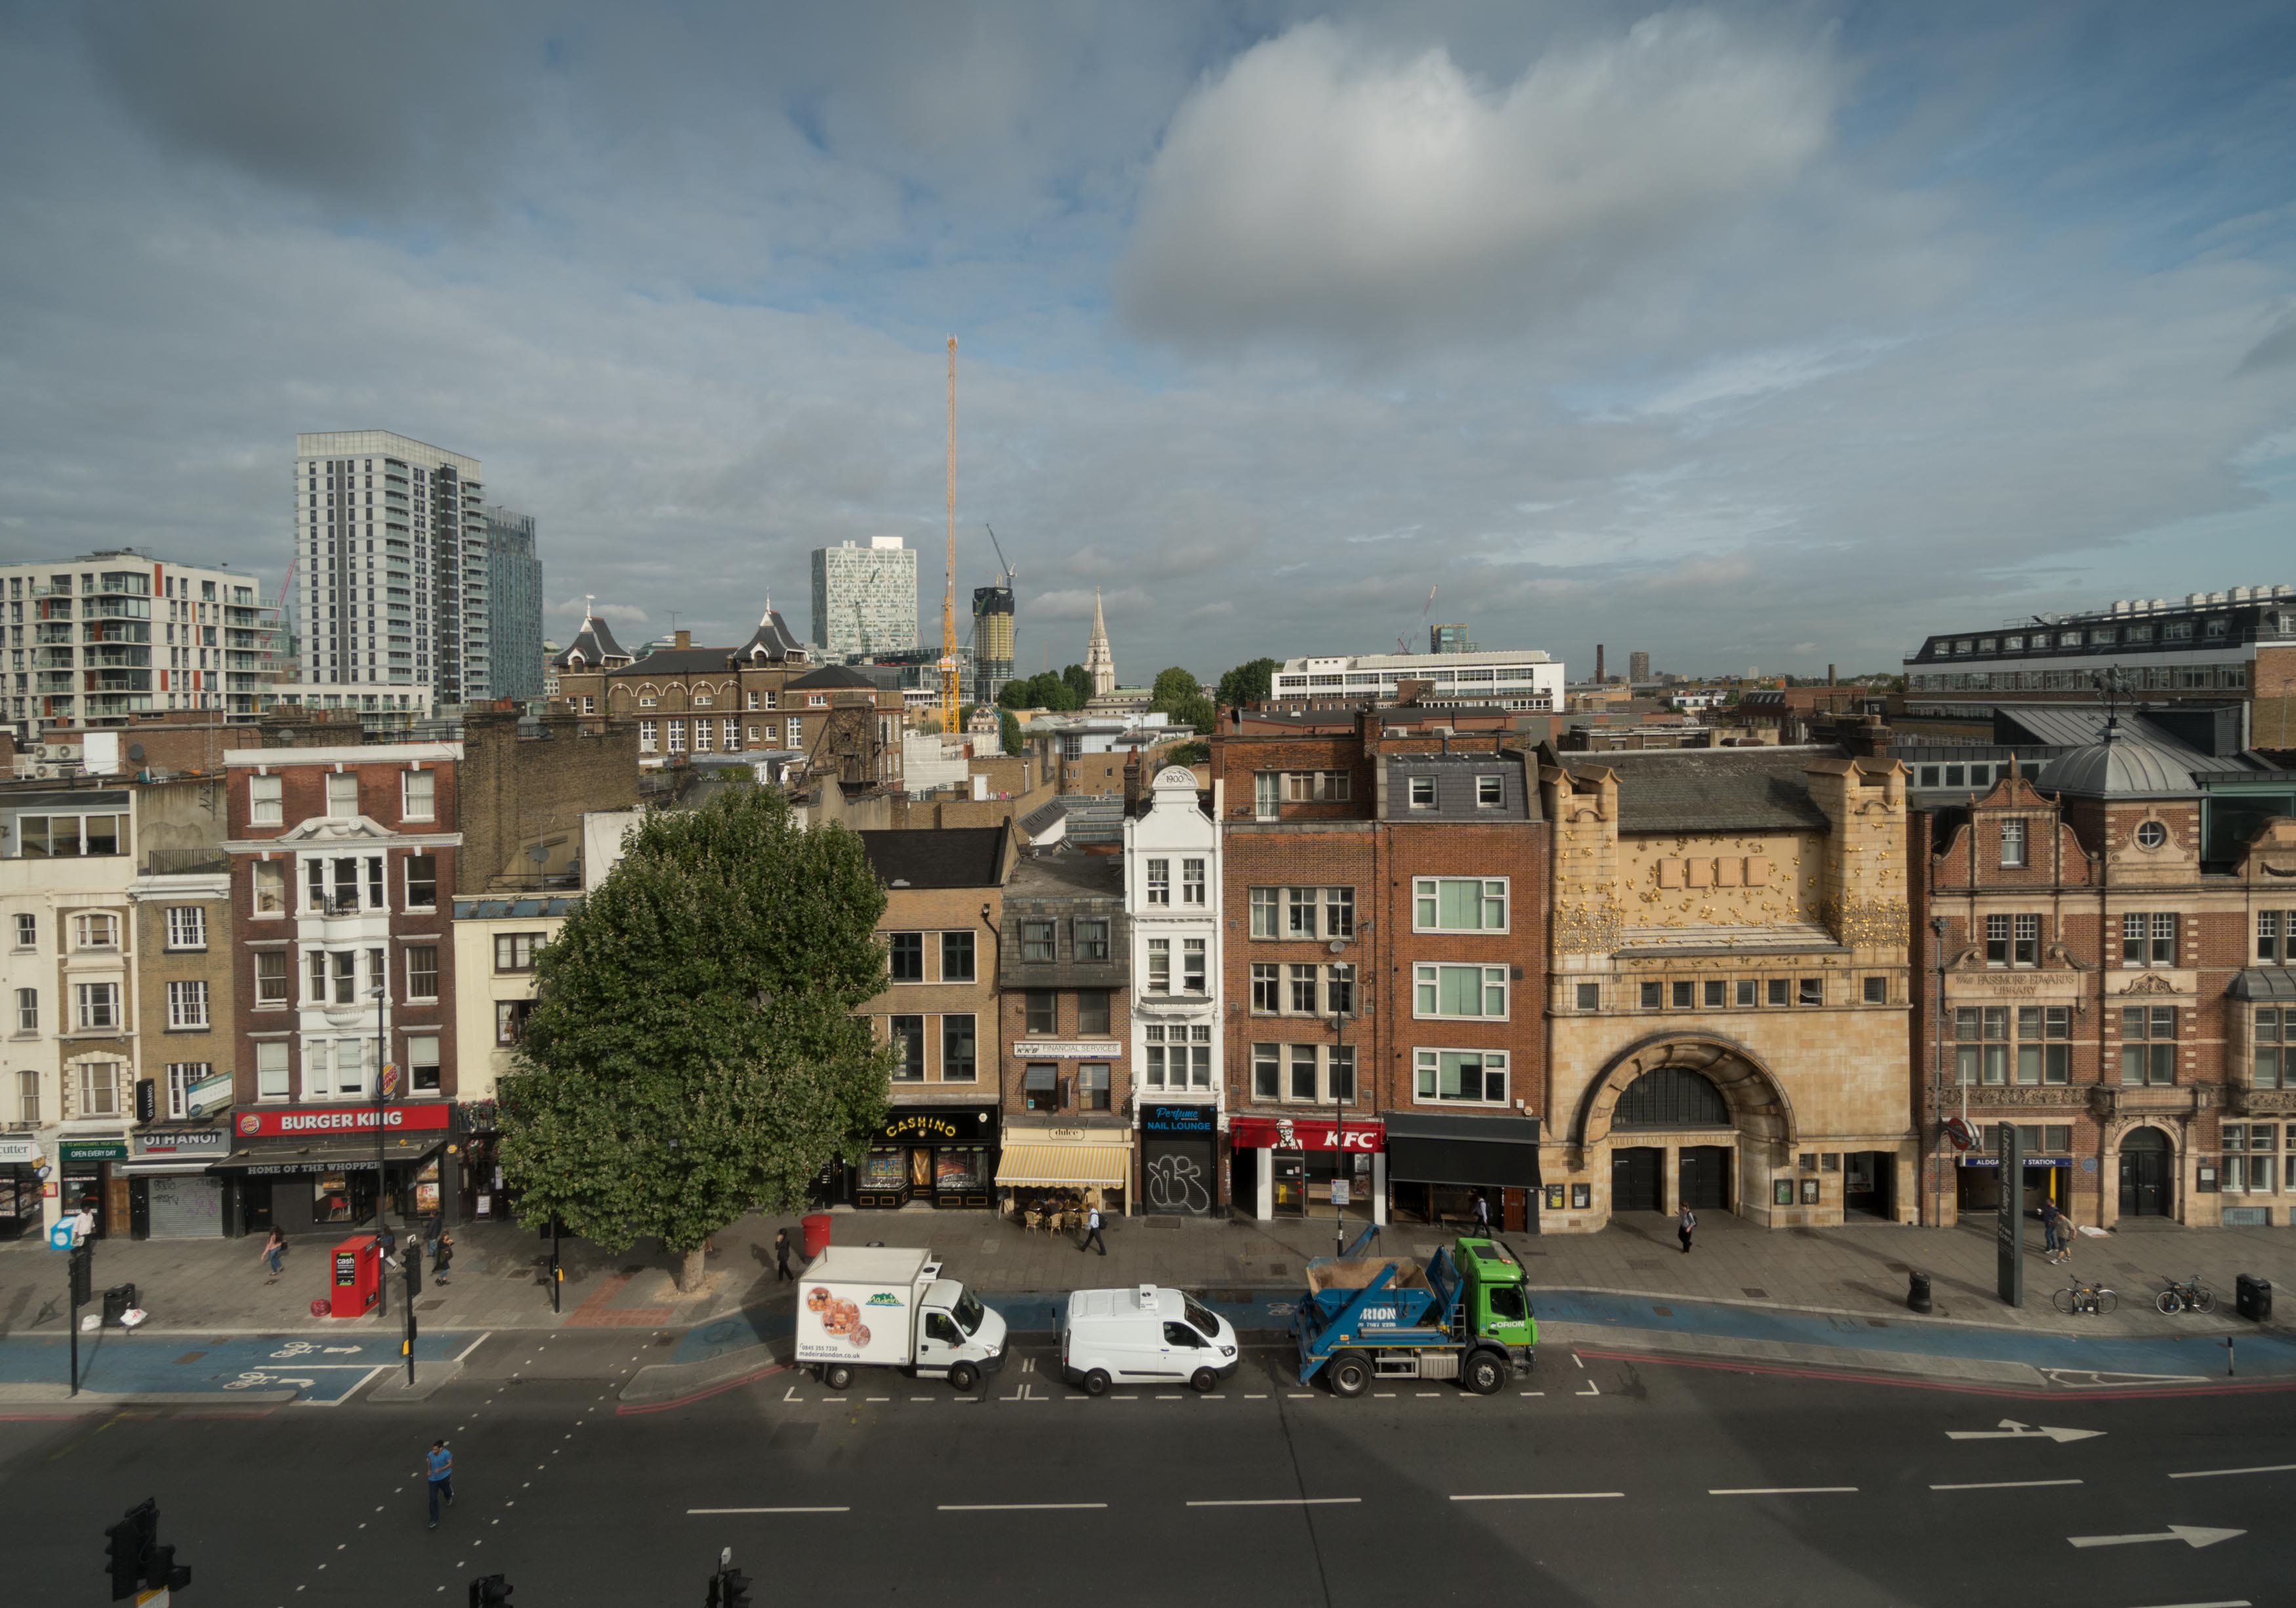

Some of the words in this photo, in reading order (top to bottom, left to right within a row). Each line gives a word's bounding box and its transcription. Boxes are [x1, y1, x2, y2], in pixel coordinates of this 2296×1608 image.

[1978, 975, 2026, 985] PASSMORE
[2030, 975, 2074, 984] EDWARDS
[1994, 986, 2036, 995] LIBRARY
[148, 1109, 154, 1117] OI
[1156, 1107, 1199, 1121] Perfume
[281, 1115, 353, 1130] BURGER
[357, 1111, 403, 1126] KING
[886, 1116, 956, 1137] CASHINO
[144, 1136, 160, 1145] OI
[165, 1134, 216, 1144] HANOI
[1323, 1130, 1376, 1148] KFC
[2000, 1128, 2011, 1184] Whitechapel
[248, 1166, 280, 1174] HOME
[302, 1164, 324, 1172] THE
[327, 1161, 380, 1171] WHOPPER
[2001, 1185, 2011, 1216] Gallery
[1359, 1308, 1396, 1319] RION
